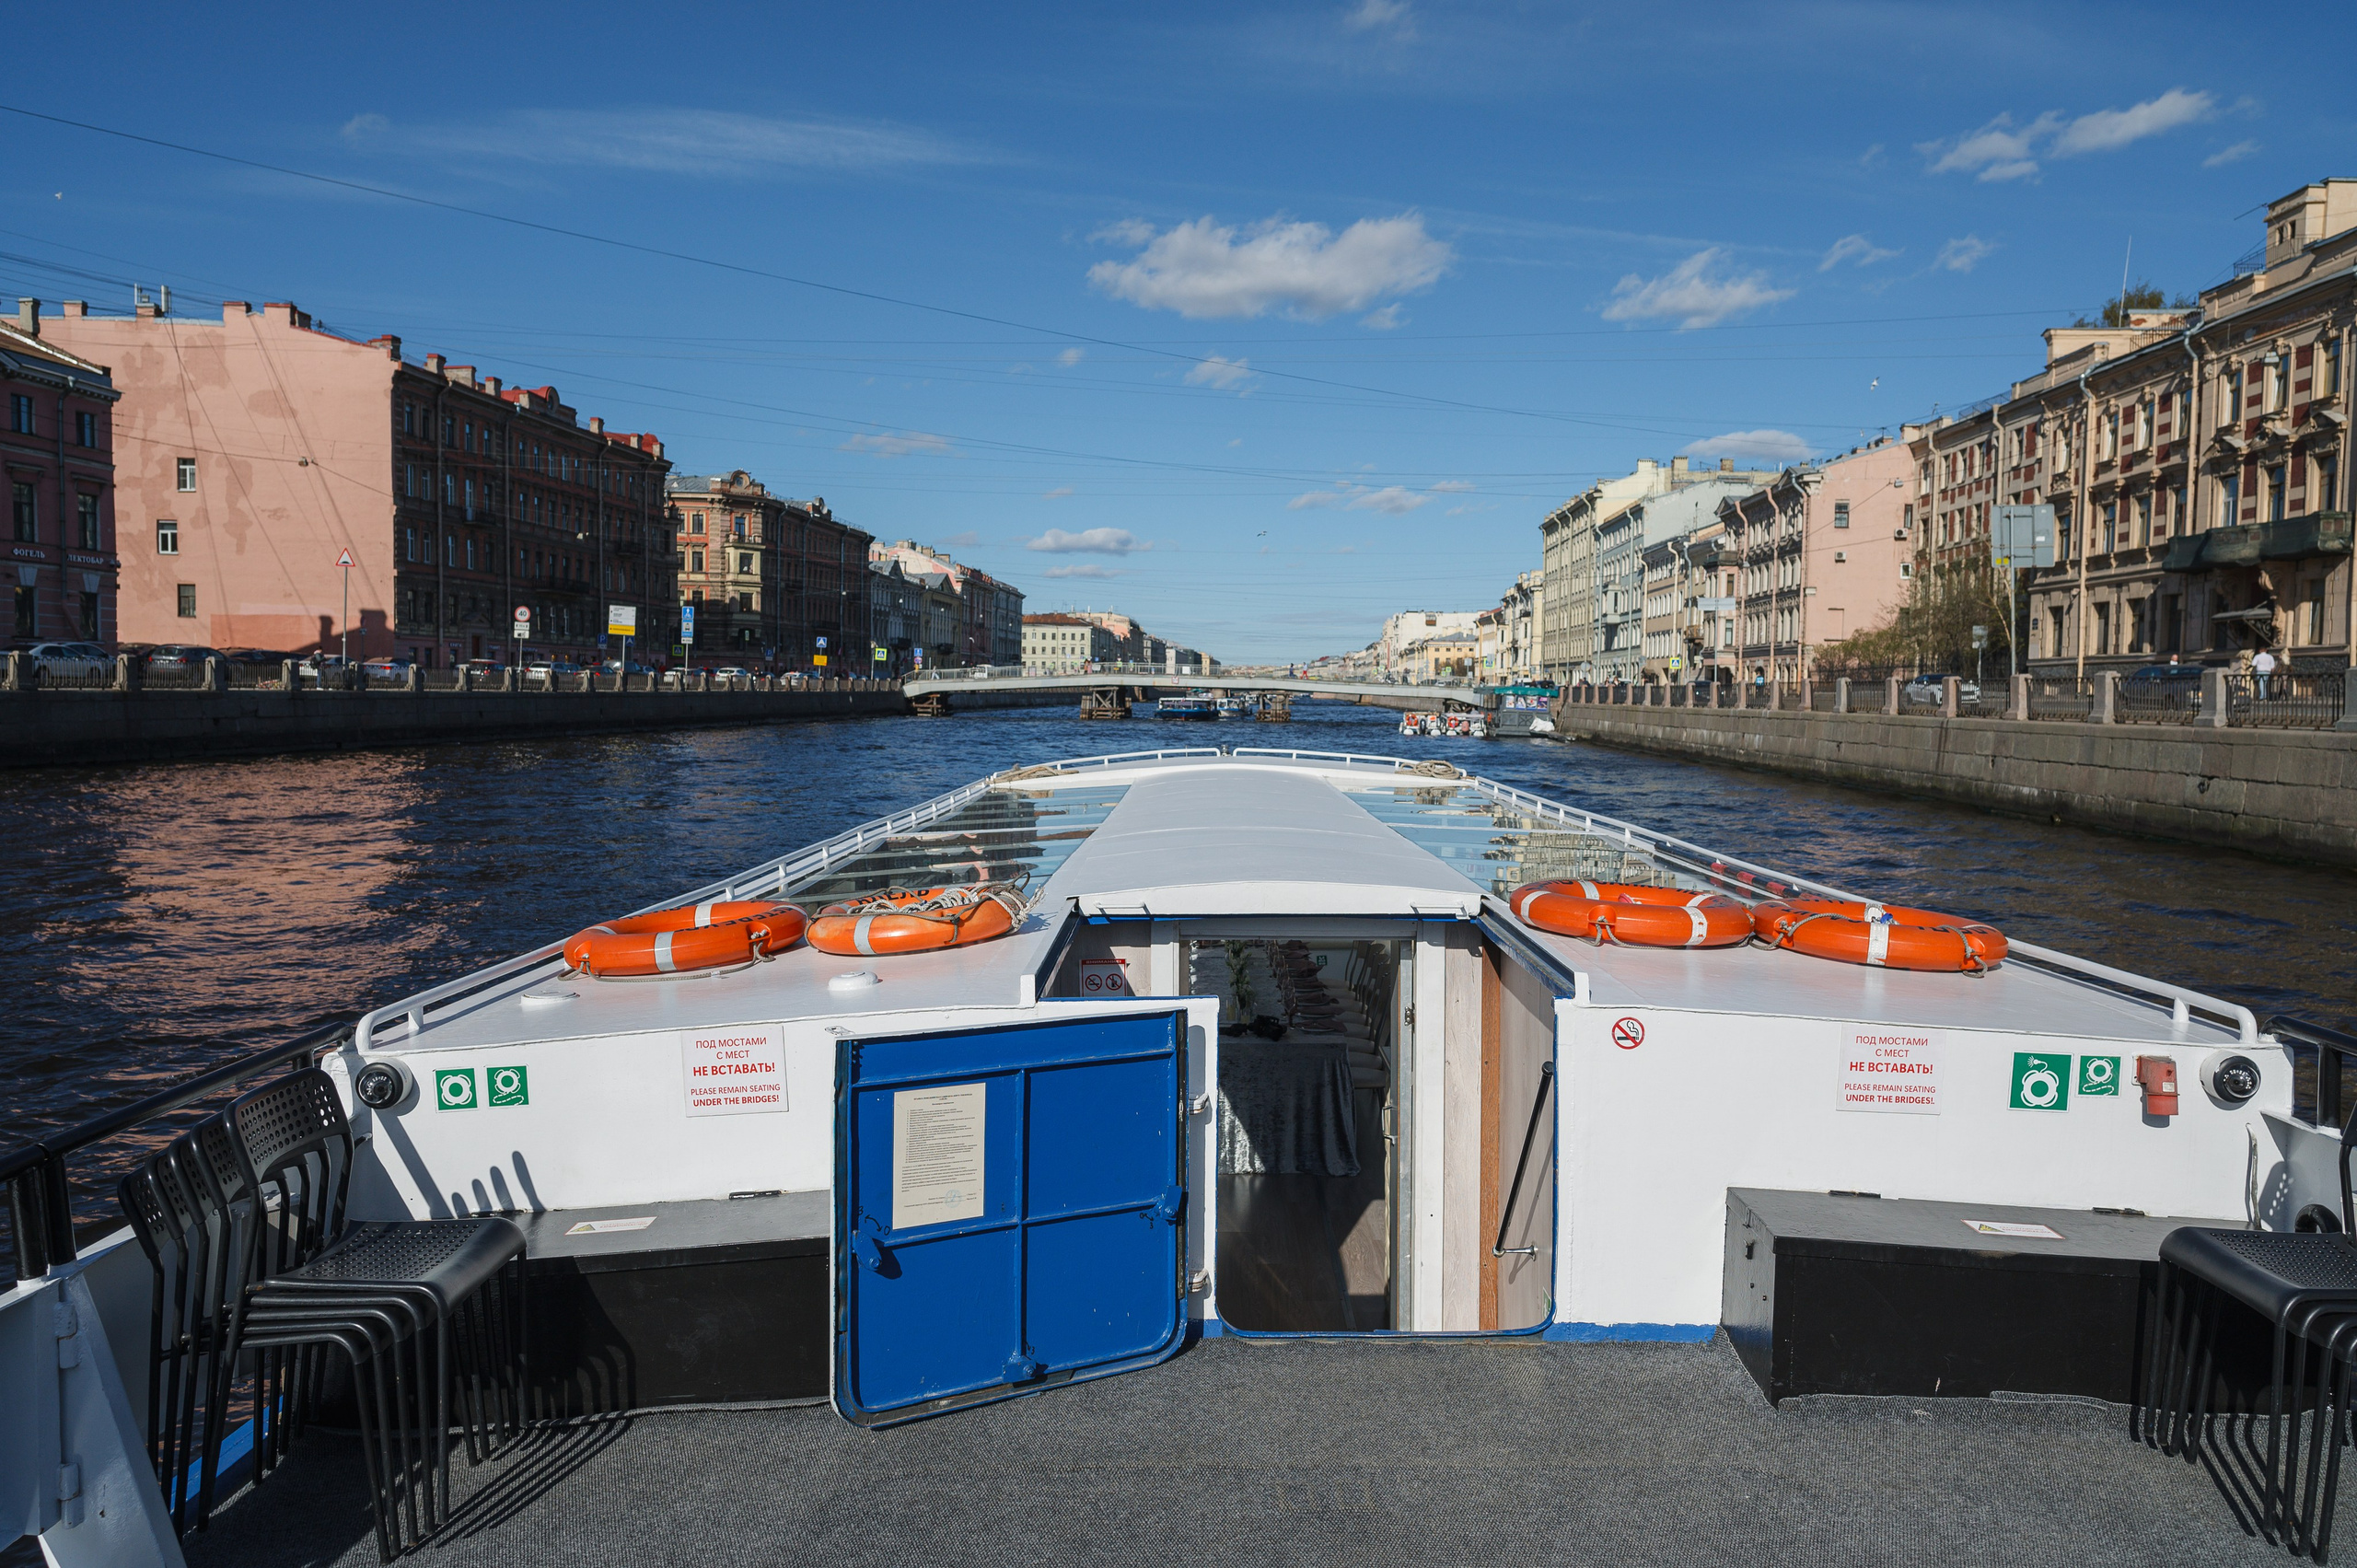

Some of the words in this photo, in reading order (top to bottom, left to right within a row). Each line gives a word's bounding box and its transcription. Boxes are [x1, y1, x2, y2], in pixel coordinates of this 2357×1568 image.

[13, 548, 45, 558] ФОГЕЛЬ
[67, 554, 104, 564] ЛЕКТОБАР
[695, 1040, 716, 1049] ПОД
[718, 1037, 767, 1047] МОСТАМИ
[1856, 1036, 1876, 1045] ПОД
[1879, 1037, 1928, 1046] МОСТАМИ
[726, 1051, 749, 1059] МЕСТ
[1885, 1049, 1910, 1058] МЕСТ
[693, 1066, 708, 1076] НЕ
[712, 1063, 775, 1075] ВСТАВАТЬ!
[1850, 1062, 1864, 1071] НЕ
[1868, 1063, 1933, 1074] ВСТАВАТЬ!
[691, 1087, 716, 1096] PLEASE
[750, 1084, 780, 1092] SEATING
[693, 1098, 722, 1107] UNDER
[742, 1095, 780, 1104] BRIDGES!
